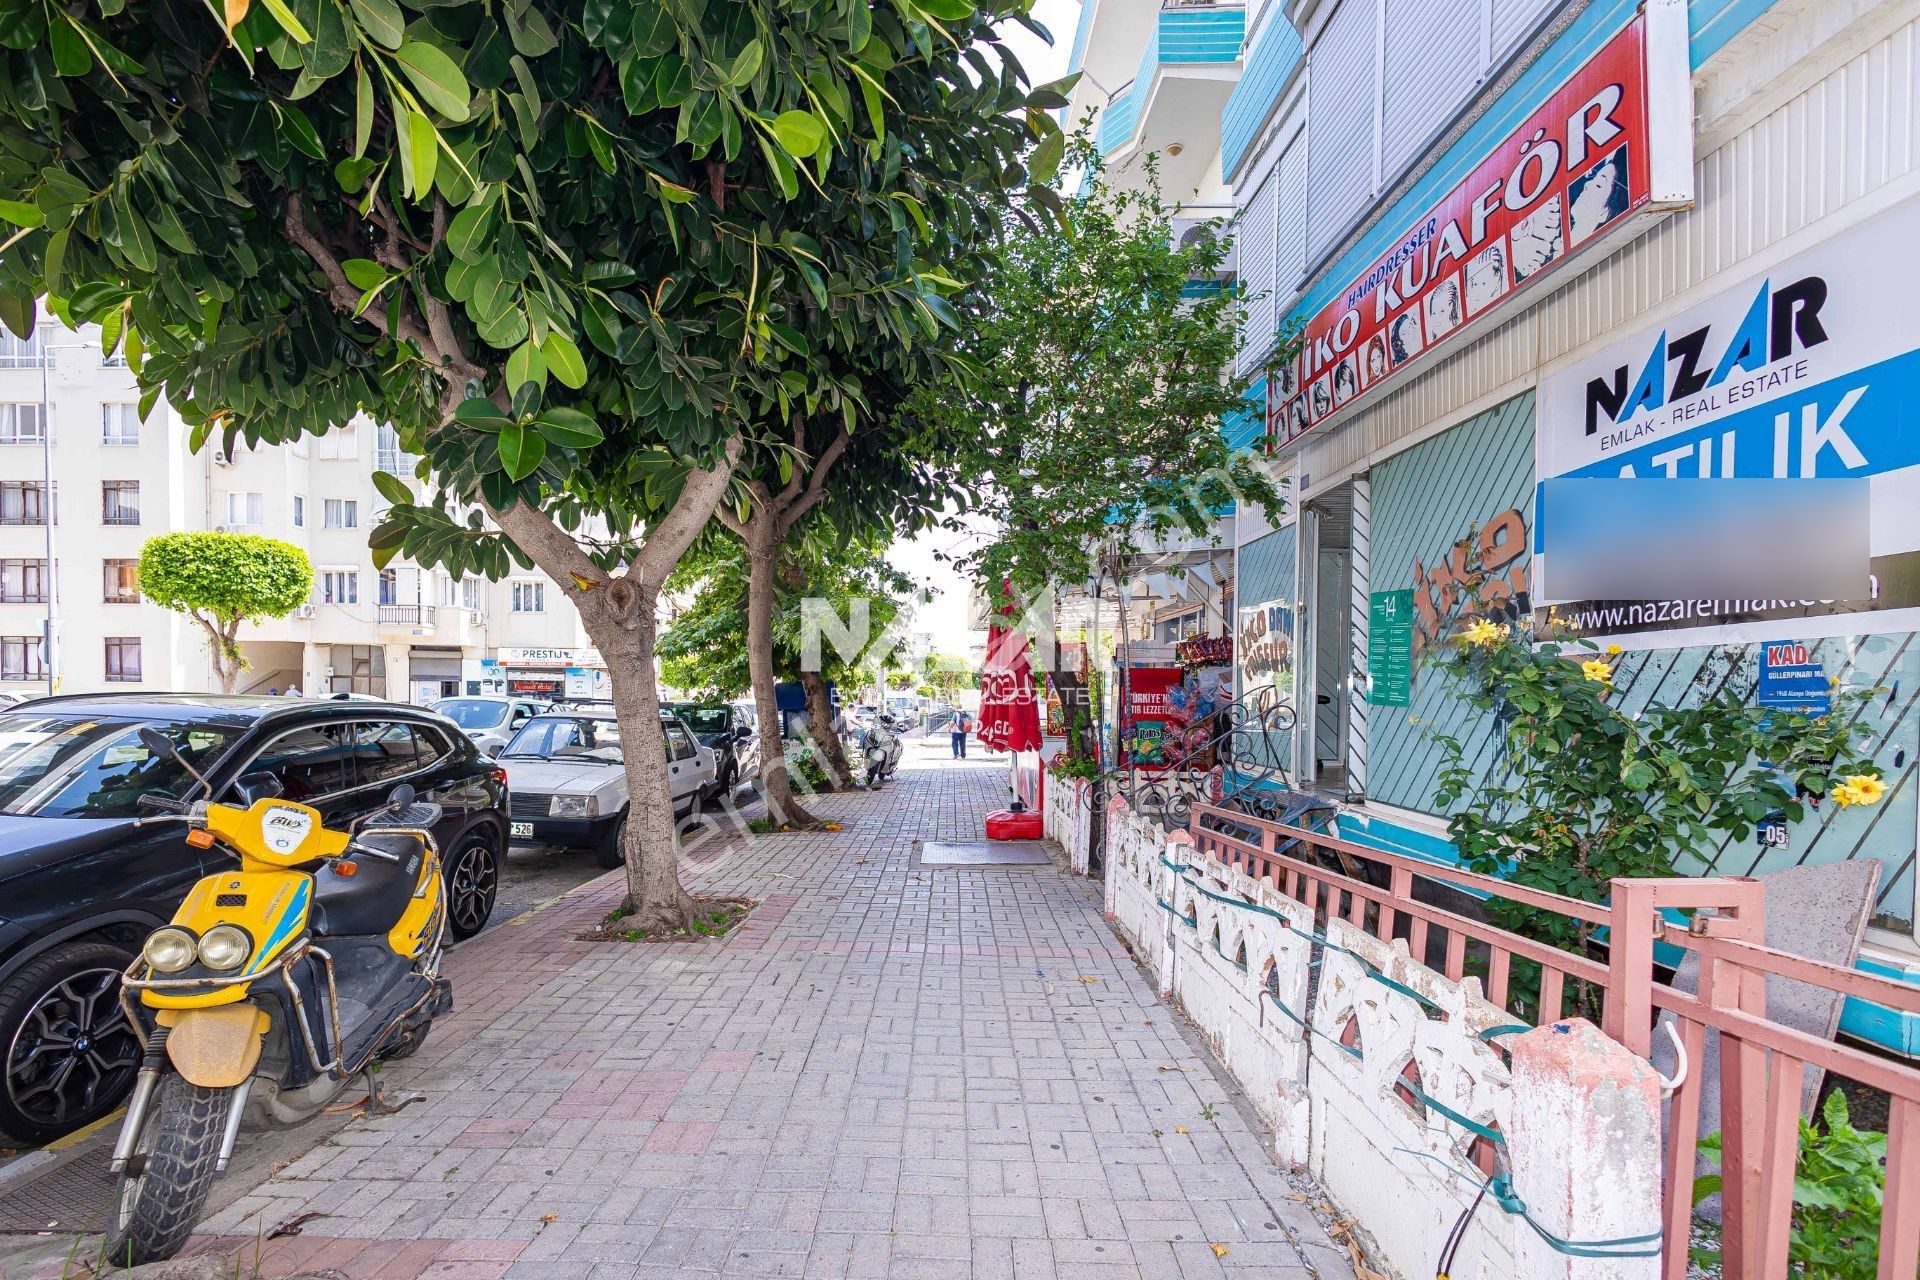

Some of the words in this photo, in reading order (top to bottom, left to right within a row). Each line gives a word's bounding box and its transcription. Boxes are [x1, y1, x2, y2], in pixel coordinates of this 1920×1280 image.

[1374, 82, 1626, 325] KUAFÖR
[1347, 217, 1436, 309] HAIRDRESSER
[1585, 276, 1828, 436] NAZAR
[1601, 418, 1655, 450] EMLAK
[1672, 395, 1721, 425] REAL
[1728, 362, 1808, 404] ESTATE
[1384, 595, 1396, 617] 14
[1767, 644, 1820, 668] KAD
